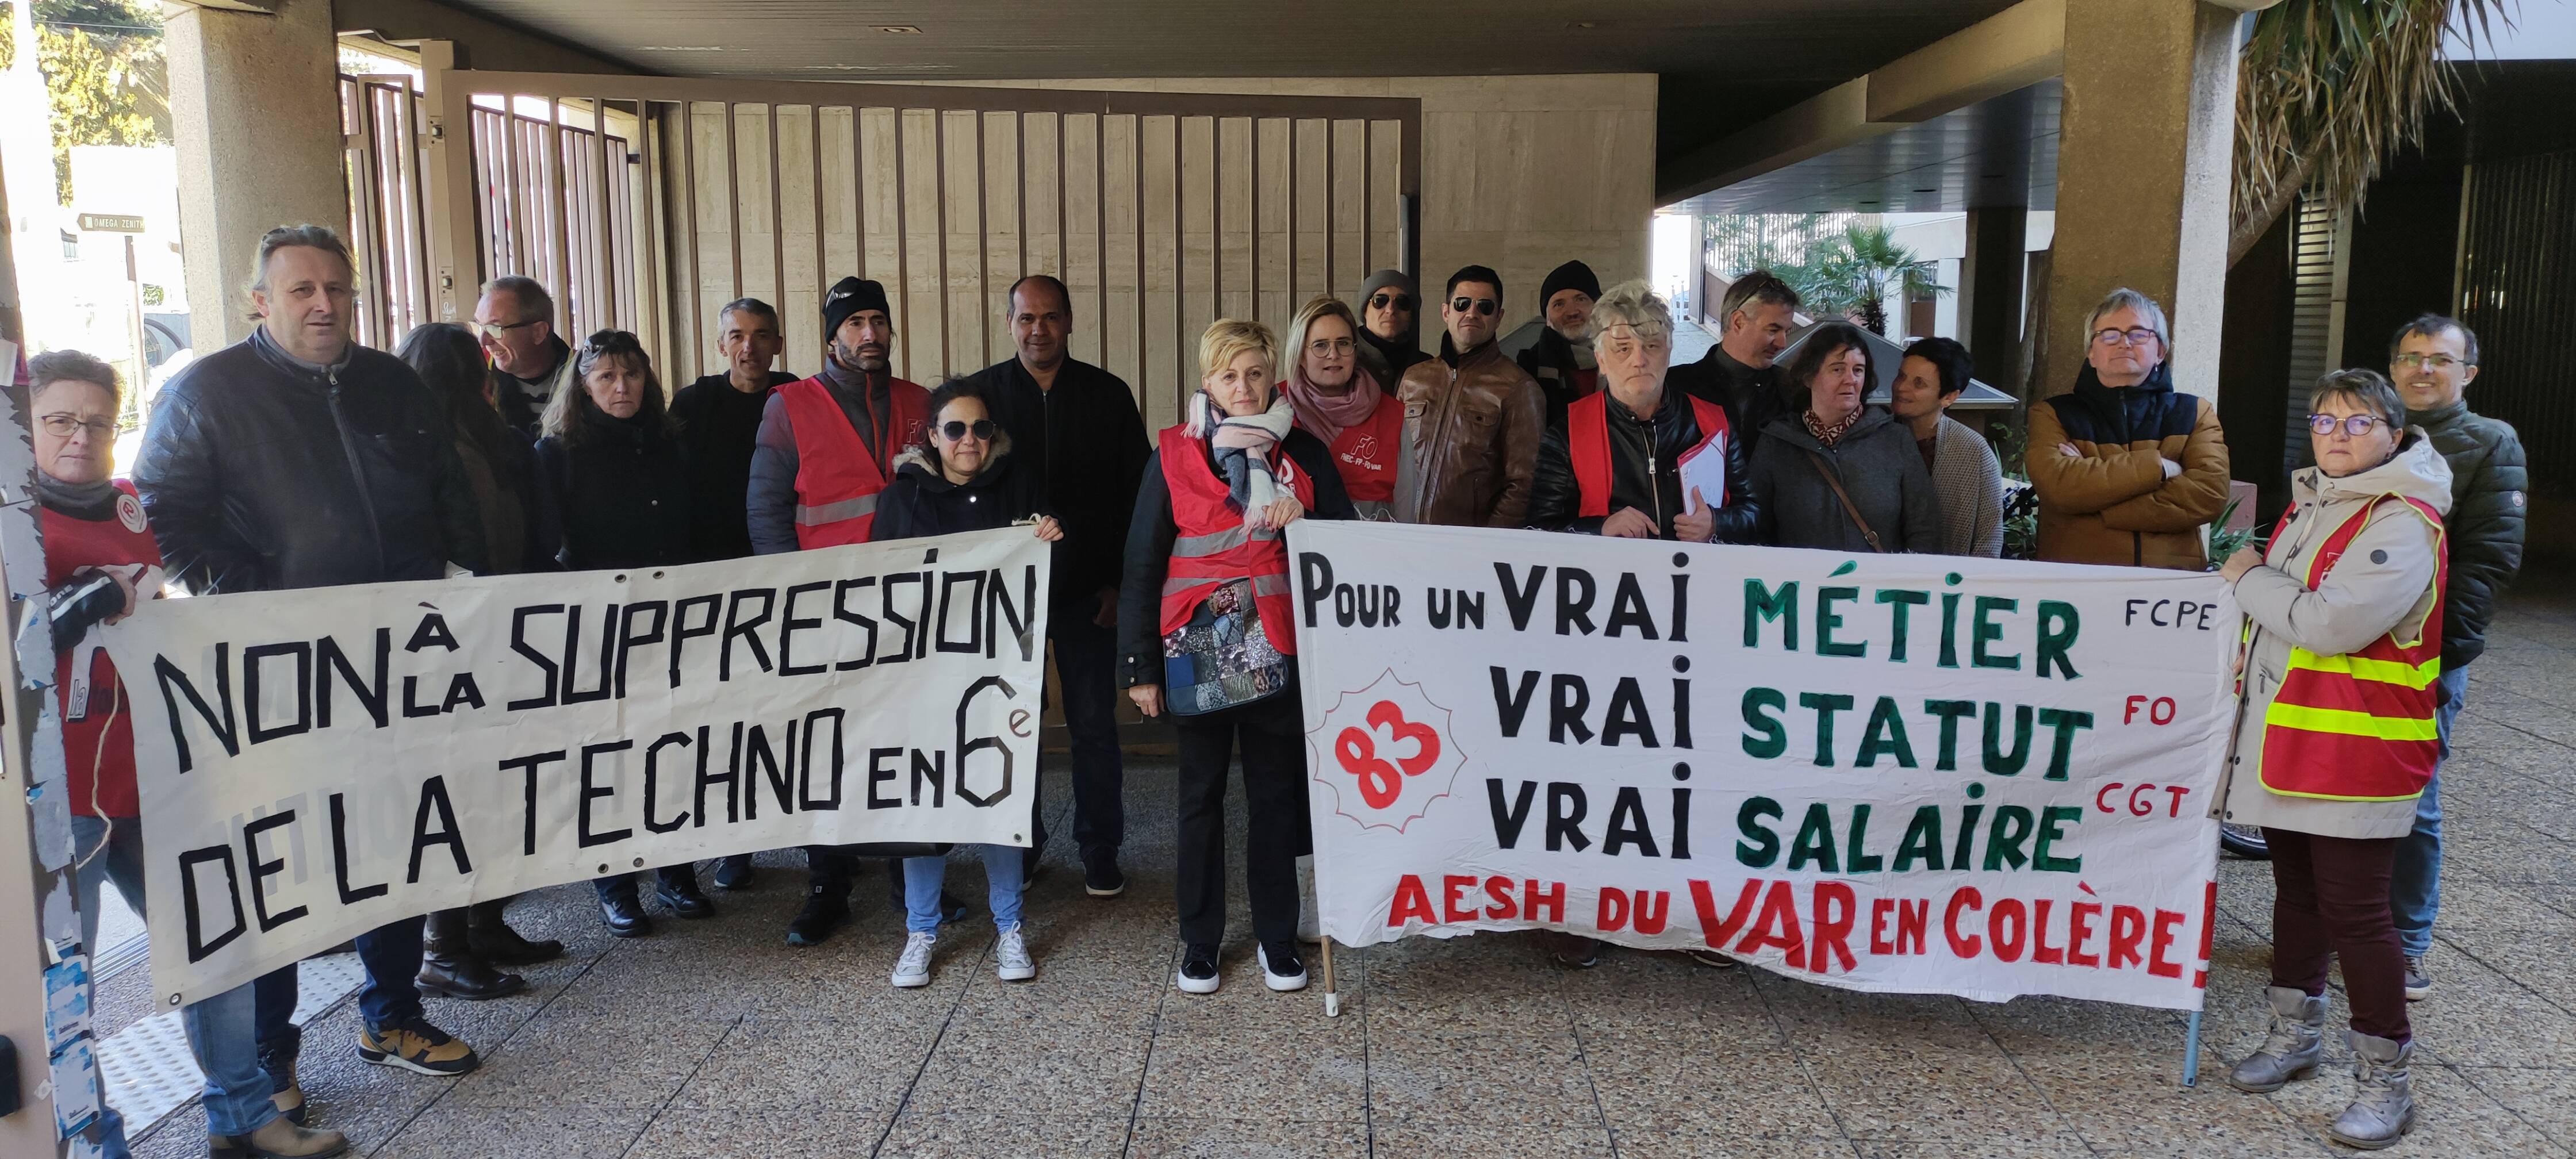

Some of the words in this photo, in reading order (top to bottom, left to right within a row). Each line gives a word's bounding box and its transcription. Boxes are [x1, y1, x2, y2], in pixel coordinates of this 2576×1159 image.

[94, 218, 118, 228] OMEGA
[121, 219, 144, 229] ZENITH
[1351, 433, 1378, 459] FO
[404, 601, 460, 653] À
[1427, 588, 1485, 630] UN
[2125, 599, 2218, 631] FCPE
[154, 627, 391, 774] NON
[403, 672, 486, 719] LA
[2123, 695, 2176, 726] FO
[1335, 700, 1441, 809] 83
[1741, 687, 2094, 781] STATUT
[499, 707, 845, 856] TECHNO
[867, 747, 945, 811] EN
[2096, 783, 2190, 818] CGT
[1387, 873, 1566, 927] AESH
[1596, 886, 1670, 934] DU
[1688, 878, 1858, 974] VAR
[1869, 897, 1929, 956] EN
